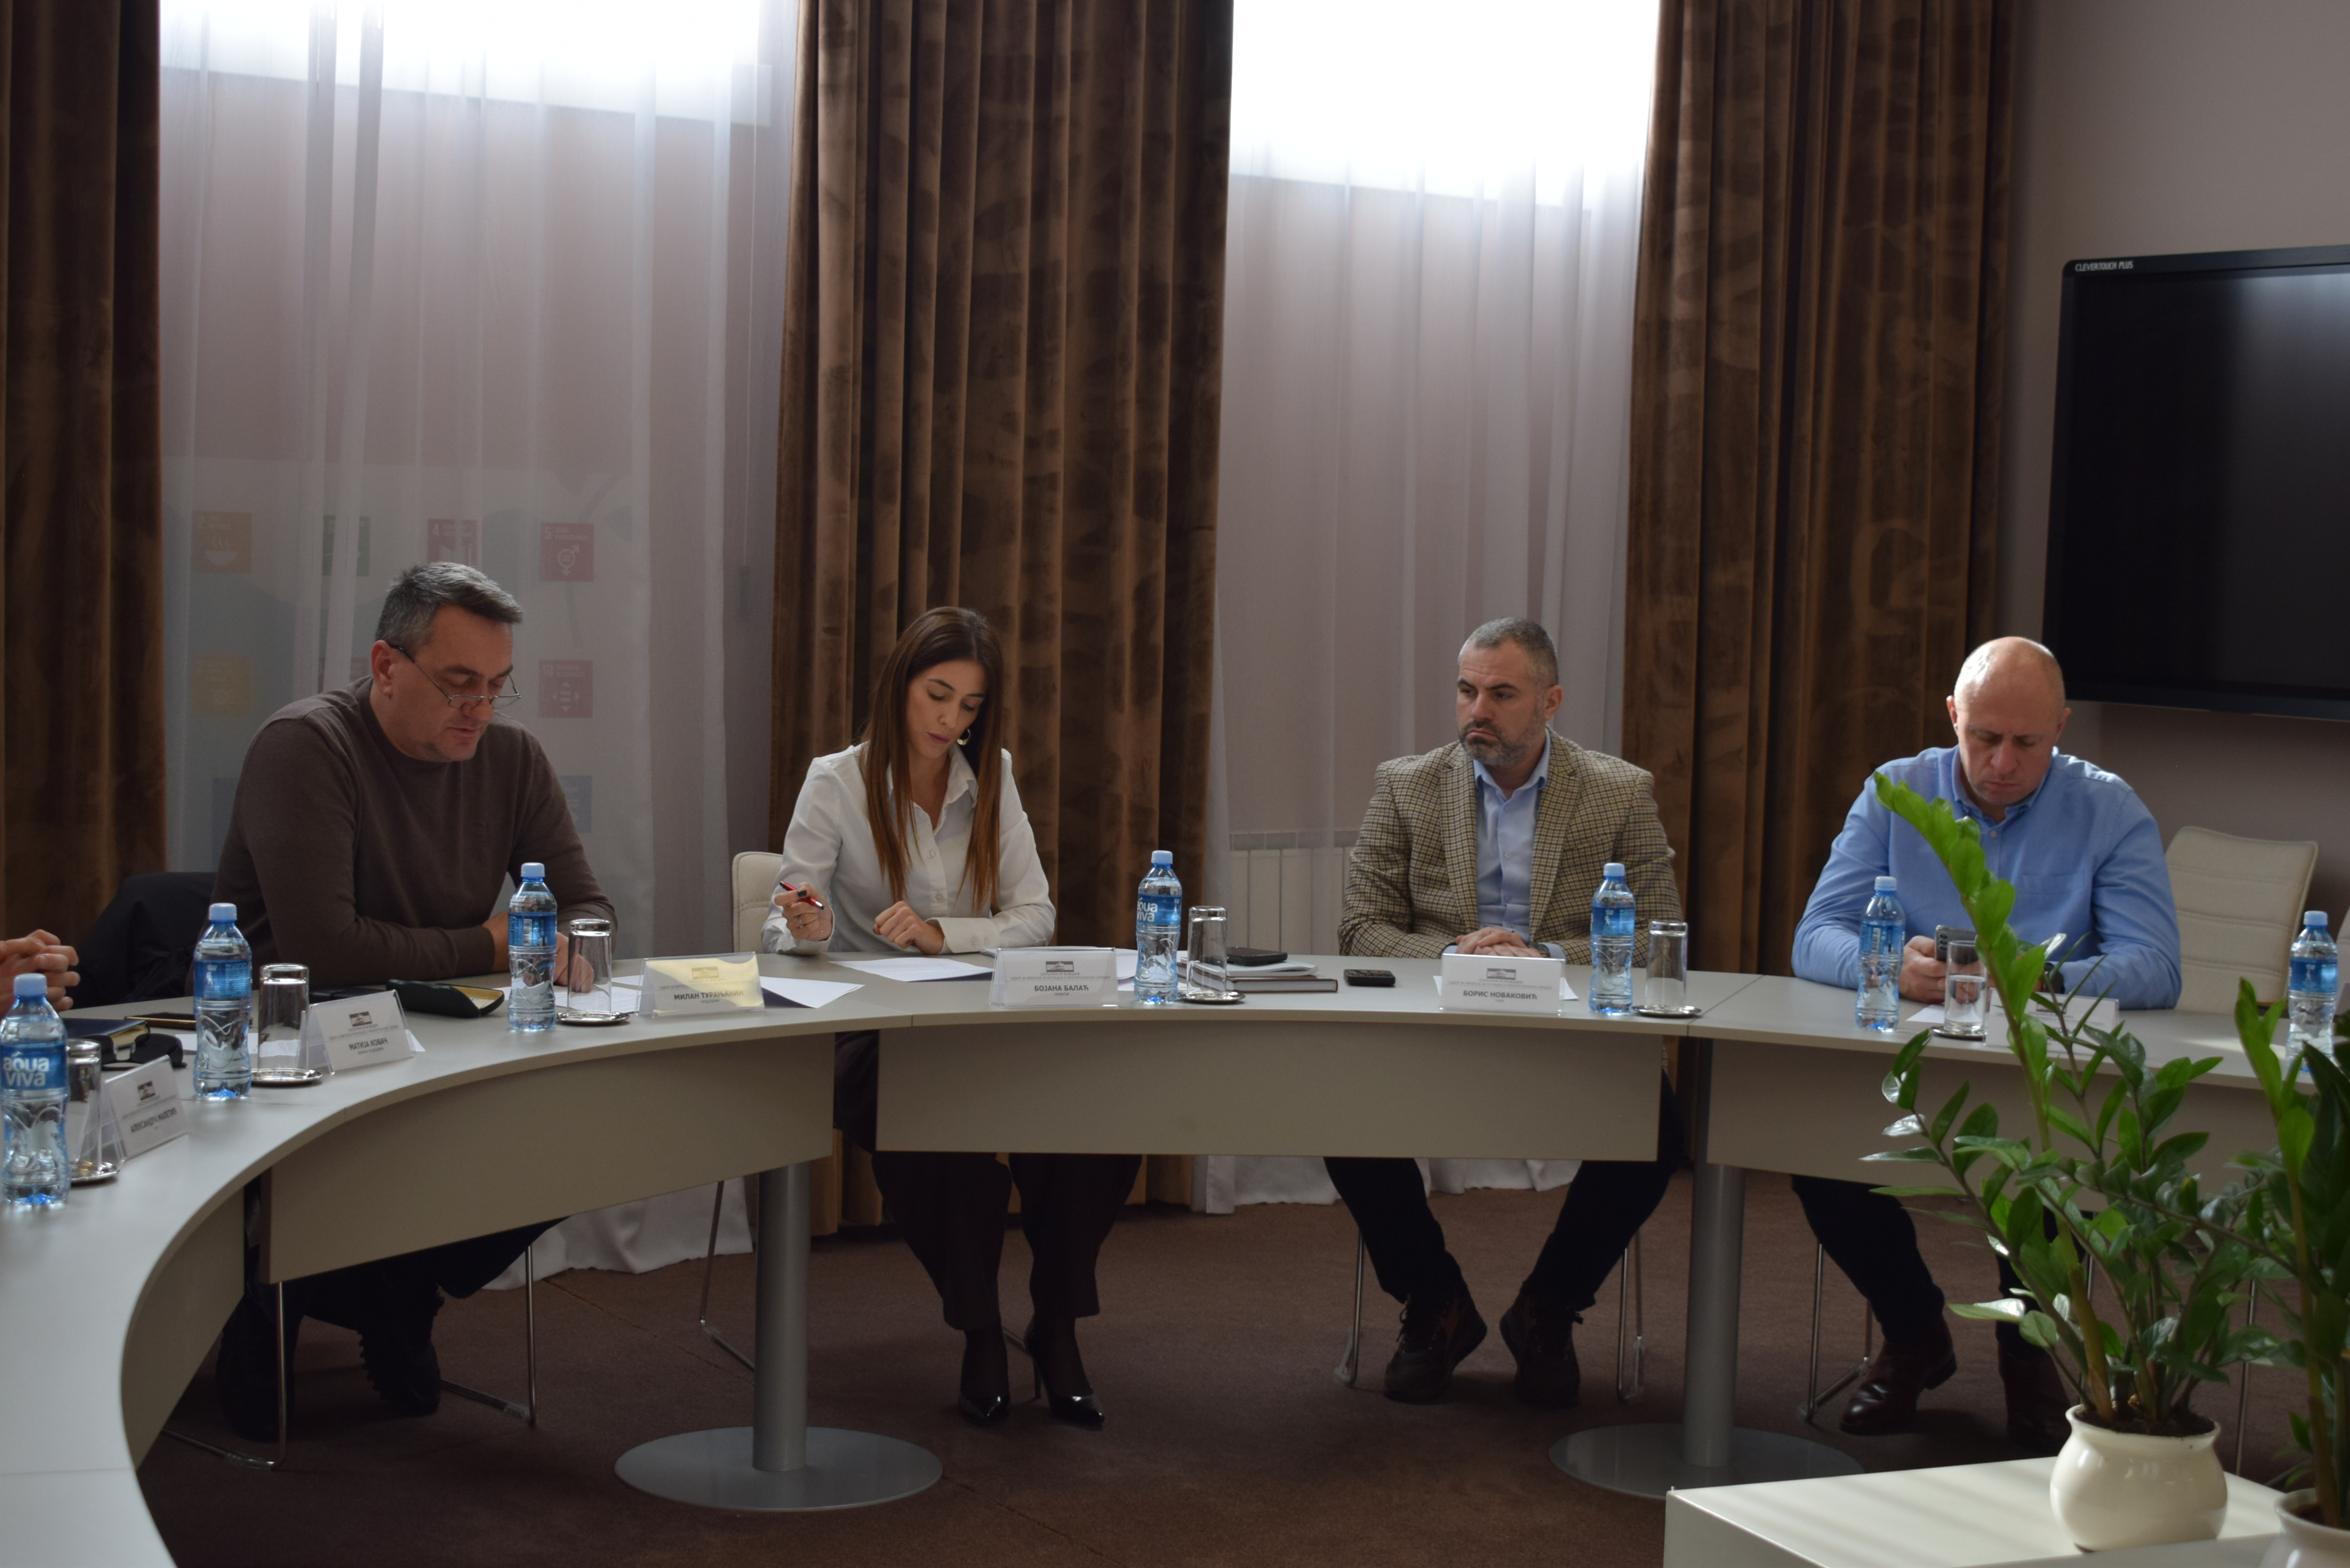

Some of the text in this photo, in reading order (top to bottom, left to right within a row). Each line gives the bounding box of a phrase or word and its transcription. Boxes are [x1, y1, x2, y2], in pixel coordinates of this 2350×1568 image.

[2075, 260, 2134, 272] CLEVERTOUCH PLUS
[433, 524, 439, 536] 4
[545, 527, 551, 540] 5
[543, 664, 554, 677] 10
[701, 990, 744, 998] ТУРАЊАНИН
[349, 1037, 388, 1050] МАТИЈА КОВАЧ
[3, 1052, 50, 1072] aqua
[5, 1071, 47, 1087] viva
